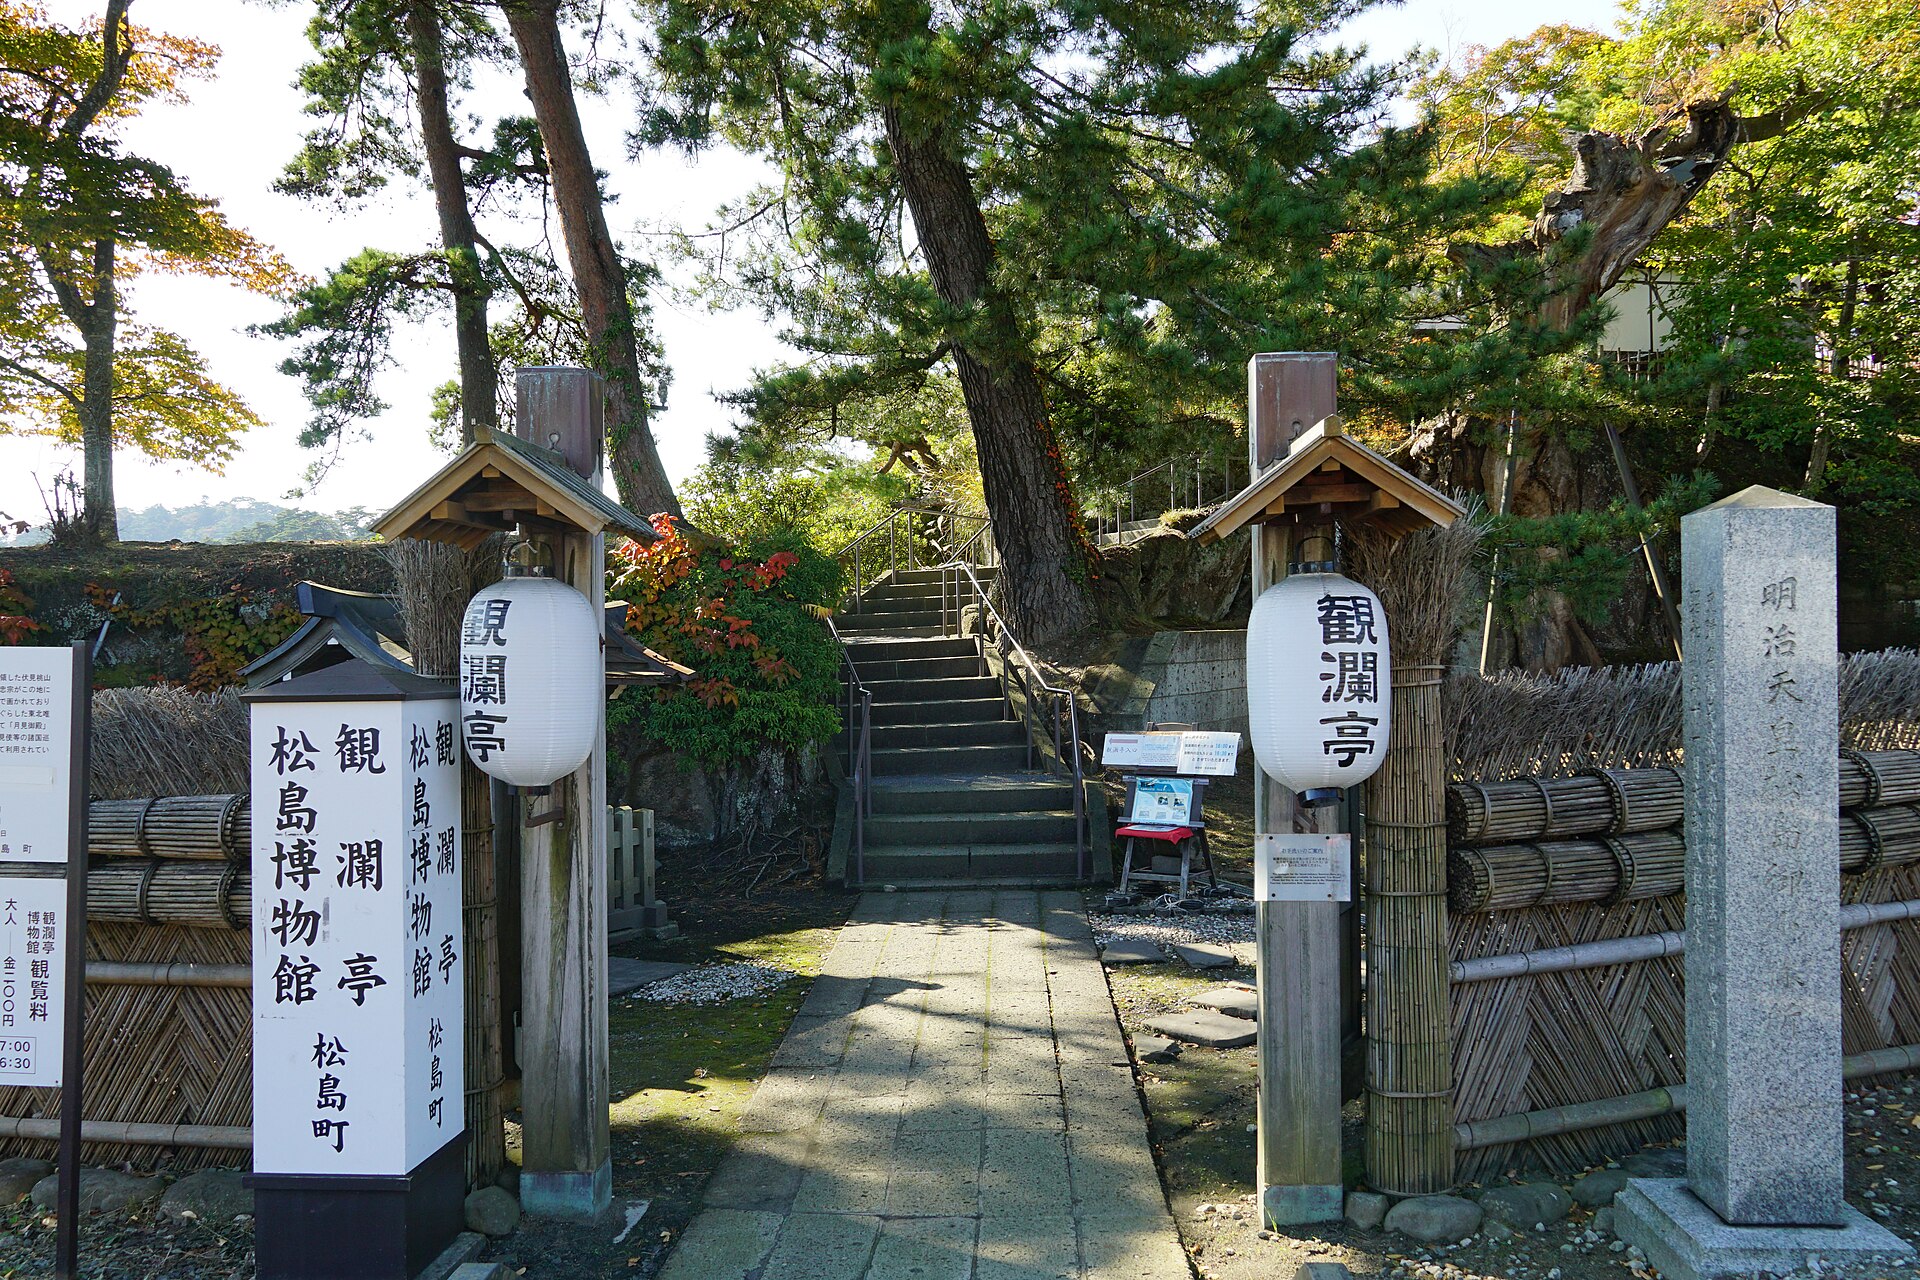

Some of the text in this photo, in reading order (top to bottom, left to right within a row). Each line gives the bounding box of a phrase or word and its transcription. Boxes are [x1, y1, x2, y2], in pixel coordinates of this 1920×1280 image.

[464, 599, 512, 763] 観瀾亭
[1317, 594, 1379, 768] 観瀾亭
[5, 898, 18, 926] 大人
[268, 725, 322, 1006] 松島博物館
[334, 723, 387, 1007] 観瀾亭
[408, 723, 432, 999] 松島博物館
[435, 719, 458, 985] 観瀾亭
[26, 910, 41, 955] 博物館
[29, 958, 50, 1023] 観覧料
[42, 911, 56, 955] 観瀾亭
[311, 1032, 350, 1153] 松島町
[429, 1017, 444, 1129] 松島町
